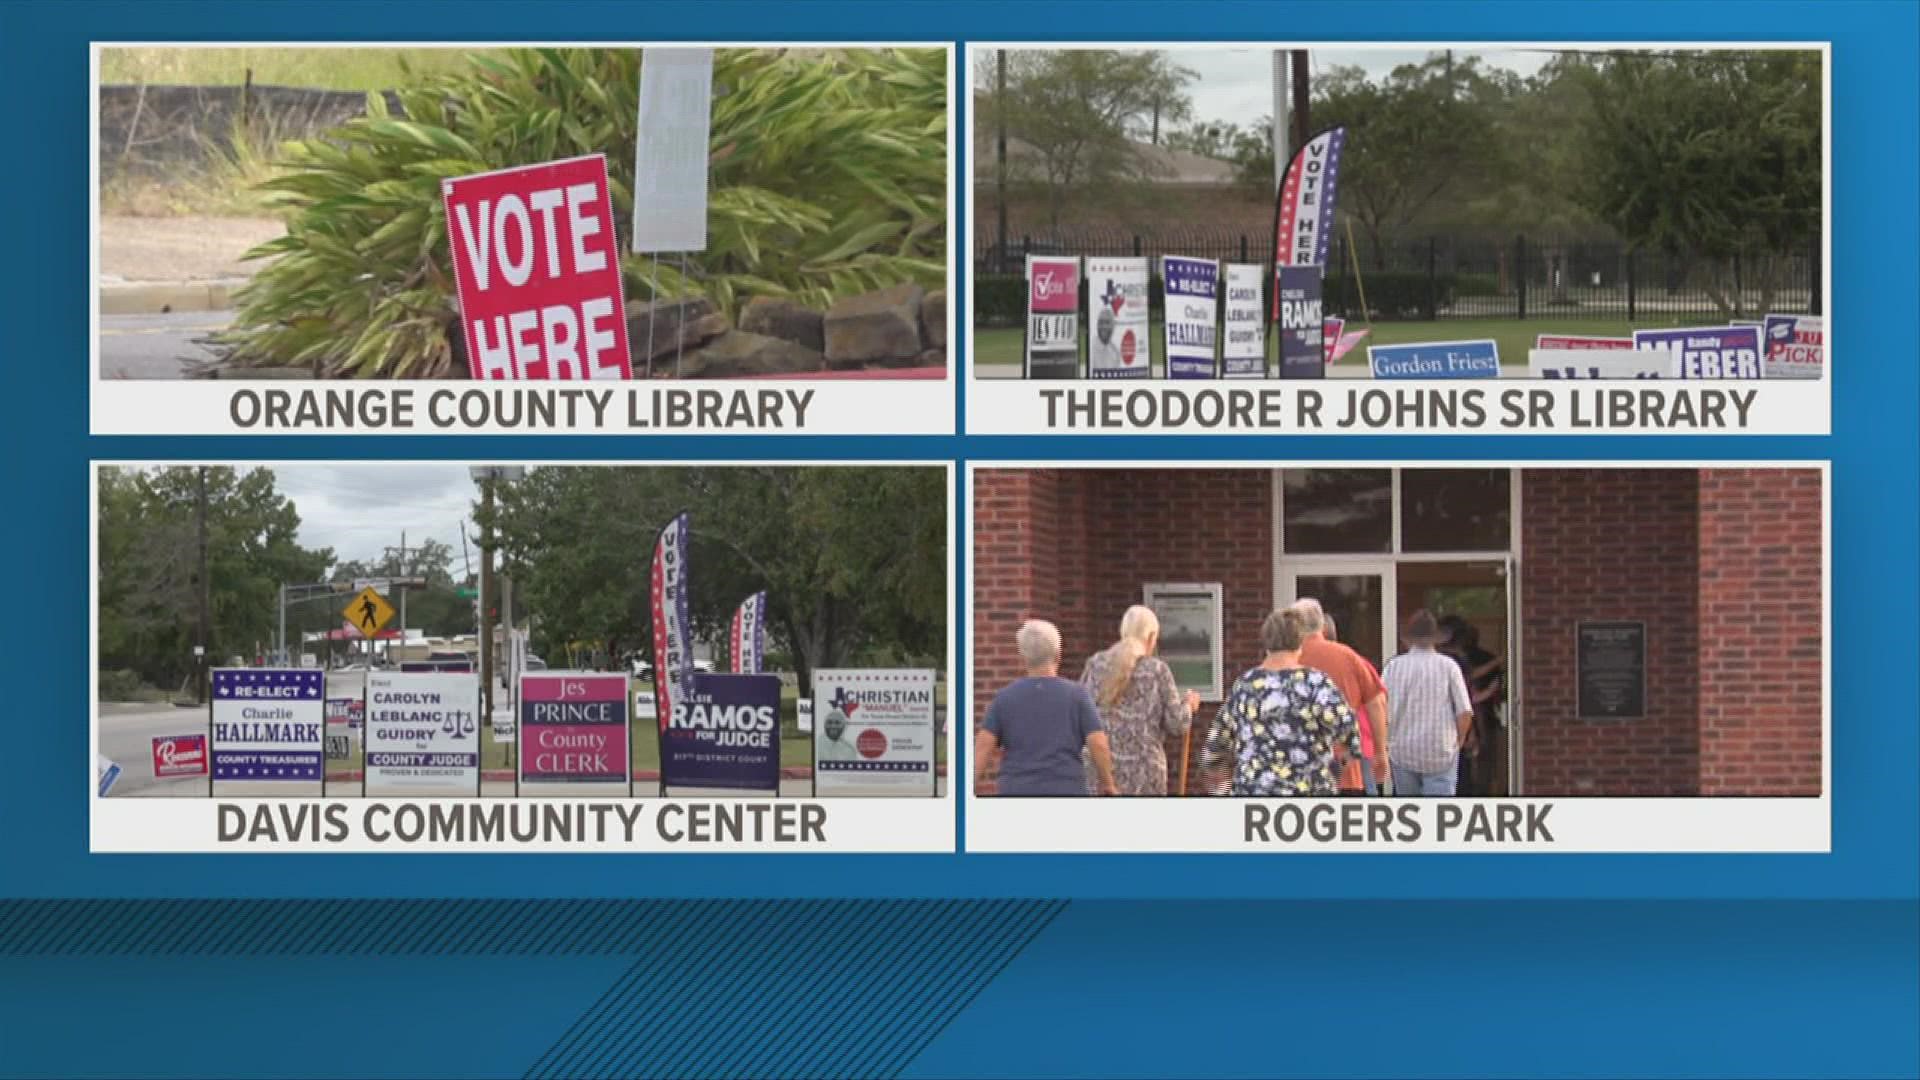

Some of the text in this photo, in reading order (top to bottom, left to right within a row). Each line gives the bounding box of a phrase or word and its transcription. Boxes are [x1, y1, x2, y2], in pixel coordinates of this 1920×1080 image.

[1297, 144, 1325, 264] VOTE HER
[455, 182, 608, 291] VOTE
[474, 296, 622, 380] HERE
[1375, 354, 1442, 376] Gordon
[235, 687, 299, 697] RE-ELECT
[374, 693, 441, 704] CAROLYN
[558, 679, 586, 700] Jes
[846, 691, 929, 704] CHRISTIAN
[242, 708, 293, 720] Charlie
[371, 711, 442, 722] LEBLANC
[534, 703, 611, 721] PRINCE
[669, 704, 774, 731] RAMOS
[215, 723, 320, 743] HALLMARK
[377, 729, 436, 740] GUIDRY
[539, 730, 606, 750] County
[696, 730, 715, 740] FOR
[715, 732, 770, 748] JUDGE
[217, 755, 317, 764] COUNTY TREASURER
[373, 754, 471, 766] COUNTY JUDGE
[536, 753, 608, 772] CLERK
